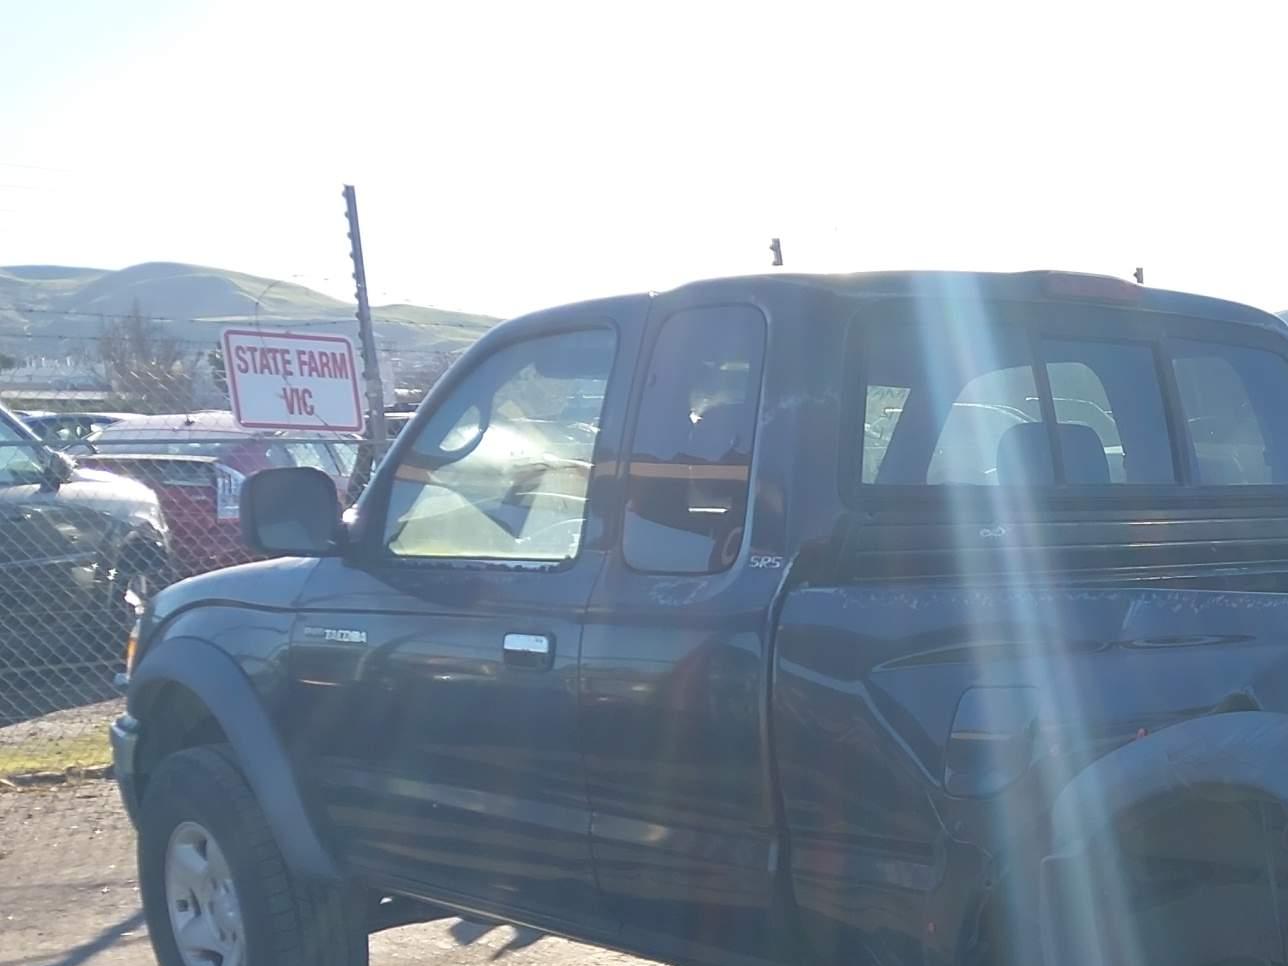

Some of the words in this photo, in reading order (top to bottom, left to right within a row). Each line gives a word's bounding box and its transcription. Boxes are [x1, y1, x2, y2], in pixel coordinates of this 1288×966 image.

[234, 345, 294, 377] STATE
[296, 349, 350, 380] FARM
[281, 386, 315, 417] VIC
